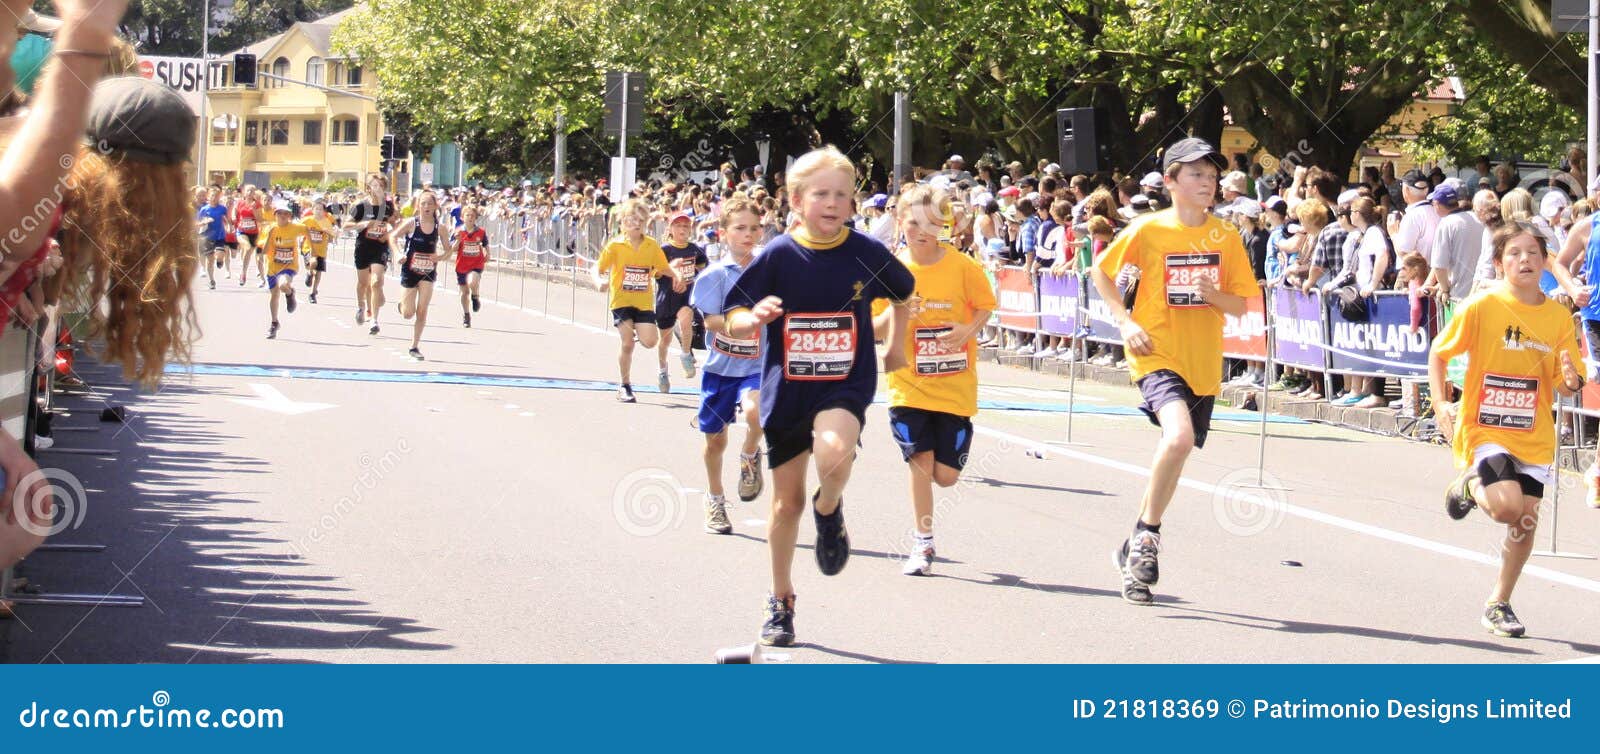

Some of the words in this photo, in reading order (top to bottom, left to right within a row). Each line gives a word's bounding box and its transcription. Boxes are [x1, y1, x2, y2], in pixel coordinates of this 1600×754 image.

[810, 320, 839, 329] adidas
[789, 332, 852, 352] 28423
[1333, 321, 1428, 353] AUCKLAND
[1504, 381, 1527, 389] adidas
[1483, 388, 1536, 408] 28582
